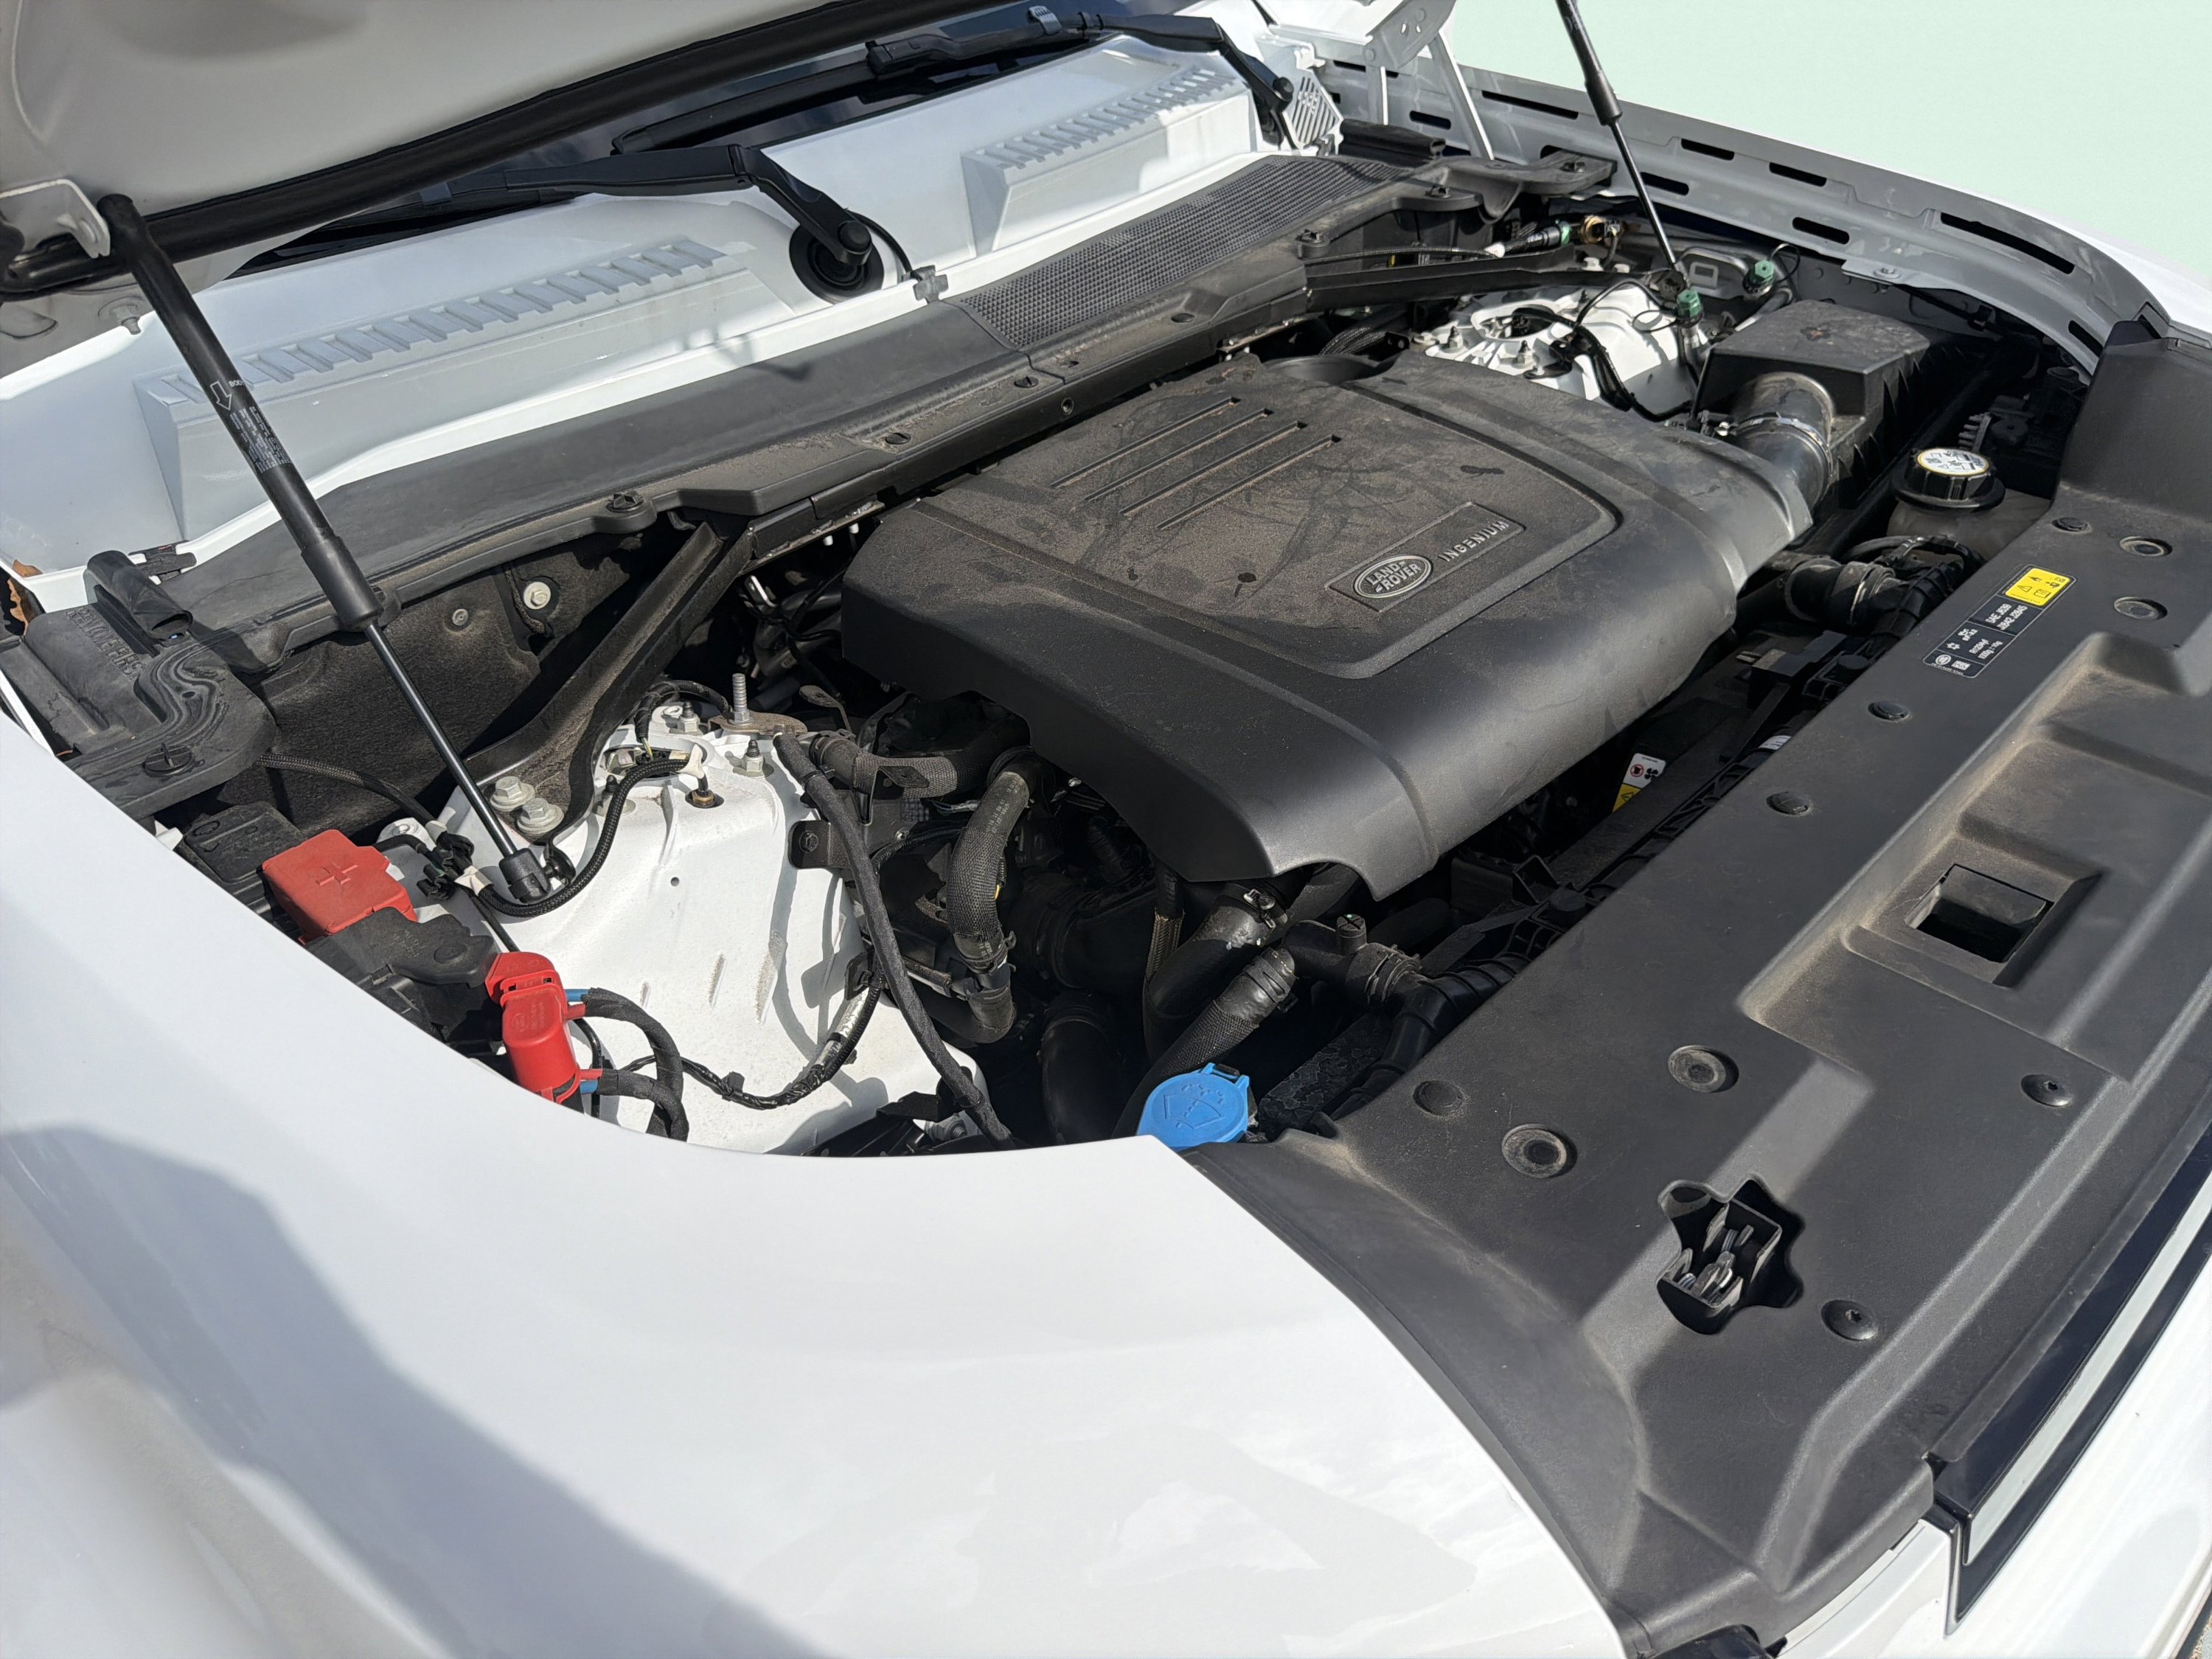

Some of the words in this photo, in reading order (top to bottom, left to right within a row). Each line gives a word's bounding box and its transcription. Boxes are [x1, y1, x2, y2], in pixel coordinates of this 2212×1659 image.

[1437, 520, 1510, 563] INGENIUM
[1365, 562, 1400, 586] LAND
[1381, 563, 1422, 591] ROVER
[1985, 613, 2001, 624] SAE
[1996, 603, 2011, 616] J639
[1997, 616, 2015, 630] J2842
[2009, 605, 2028, 619] J2845
[1969, 639, 1989, 654] R1234yf
